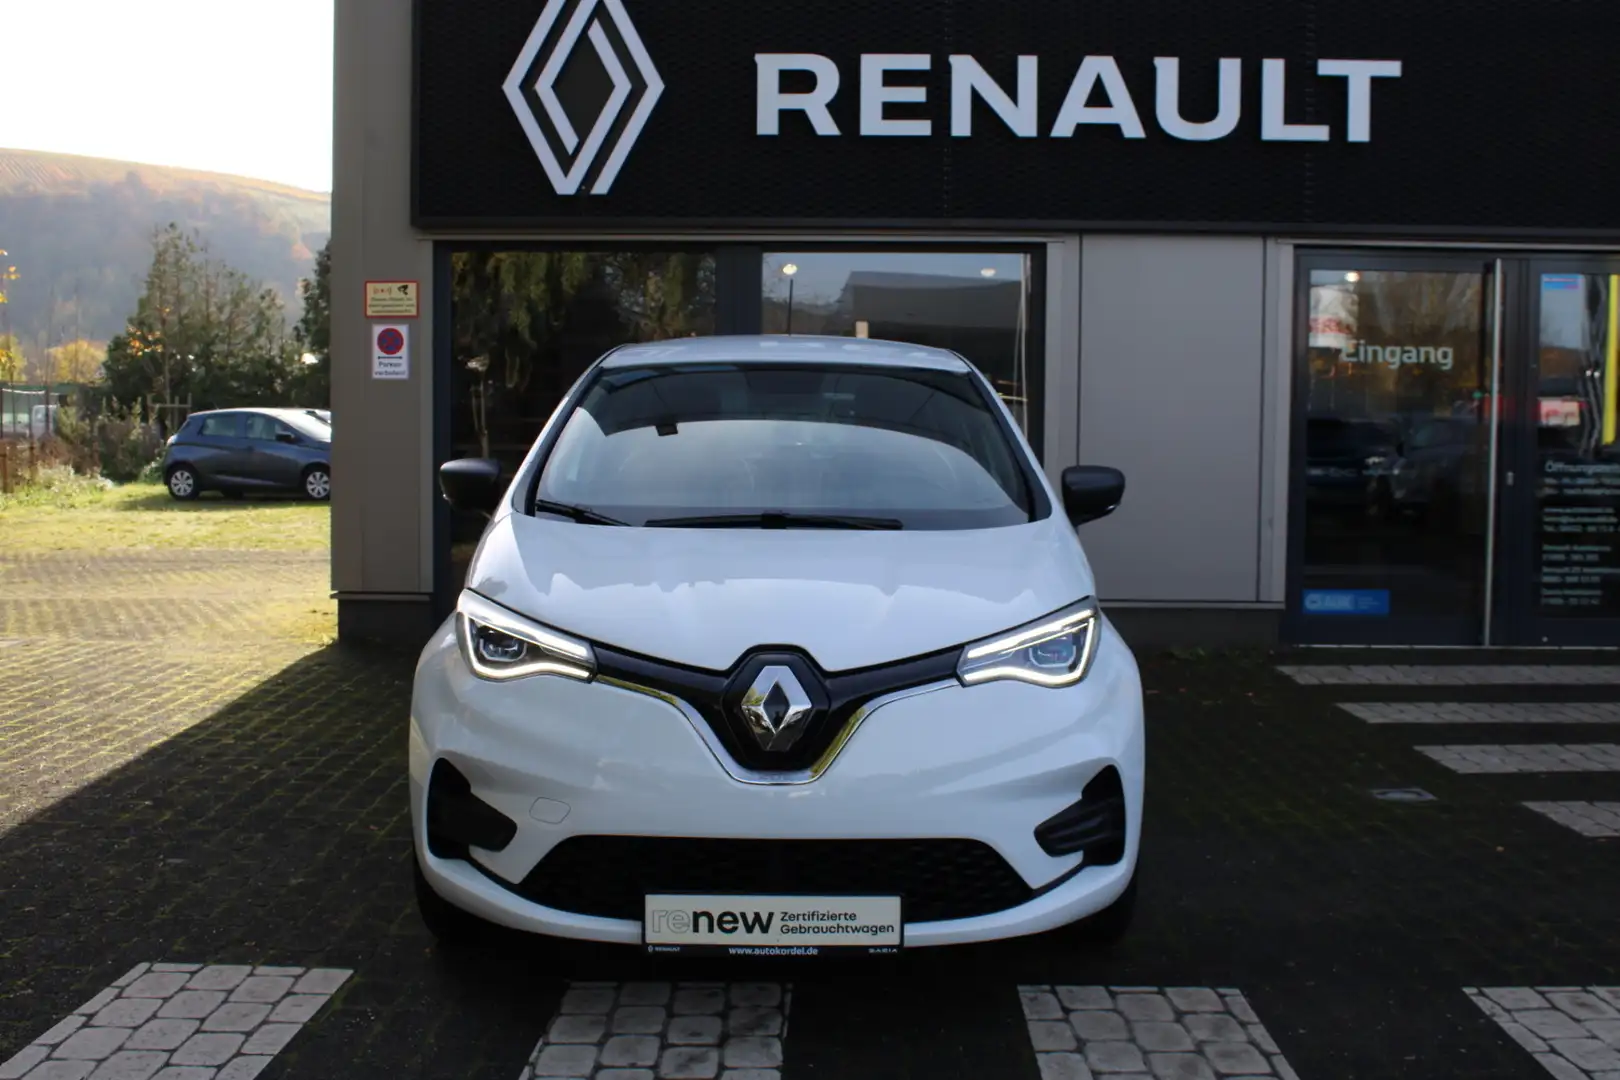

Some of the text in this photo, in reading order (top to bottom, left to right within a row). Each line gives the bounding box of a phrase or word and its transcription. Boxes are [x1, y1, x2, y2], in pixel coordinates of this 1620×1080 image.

[754, 52, 1402, 143] RENAULT
[1339, 339, 1455, 370] Eingang
[651, 909, 775, 935] renew
[780, 910, 858, 922] Zertifizierte
[780, 922, 895, 936] Gebrauchtwagen
[728, 945, 819, 956] www.autokordel.de
